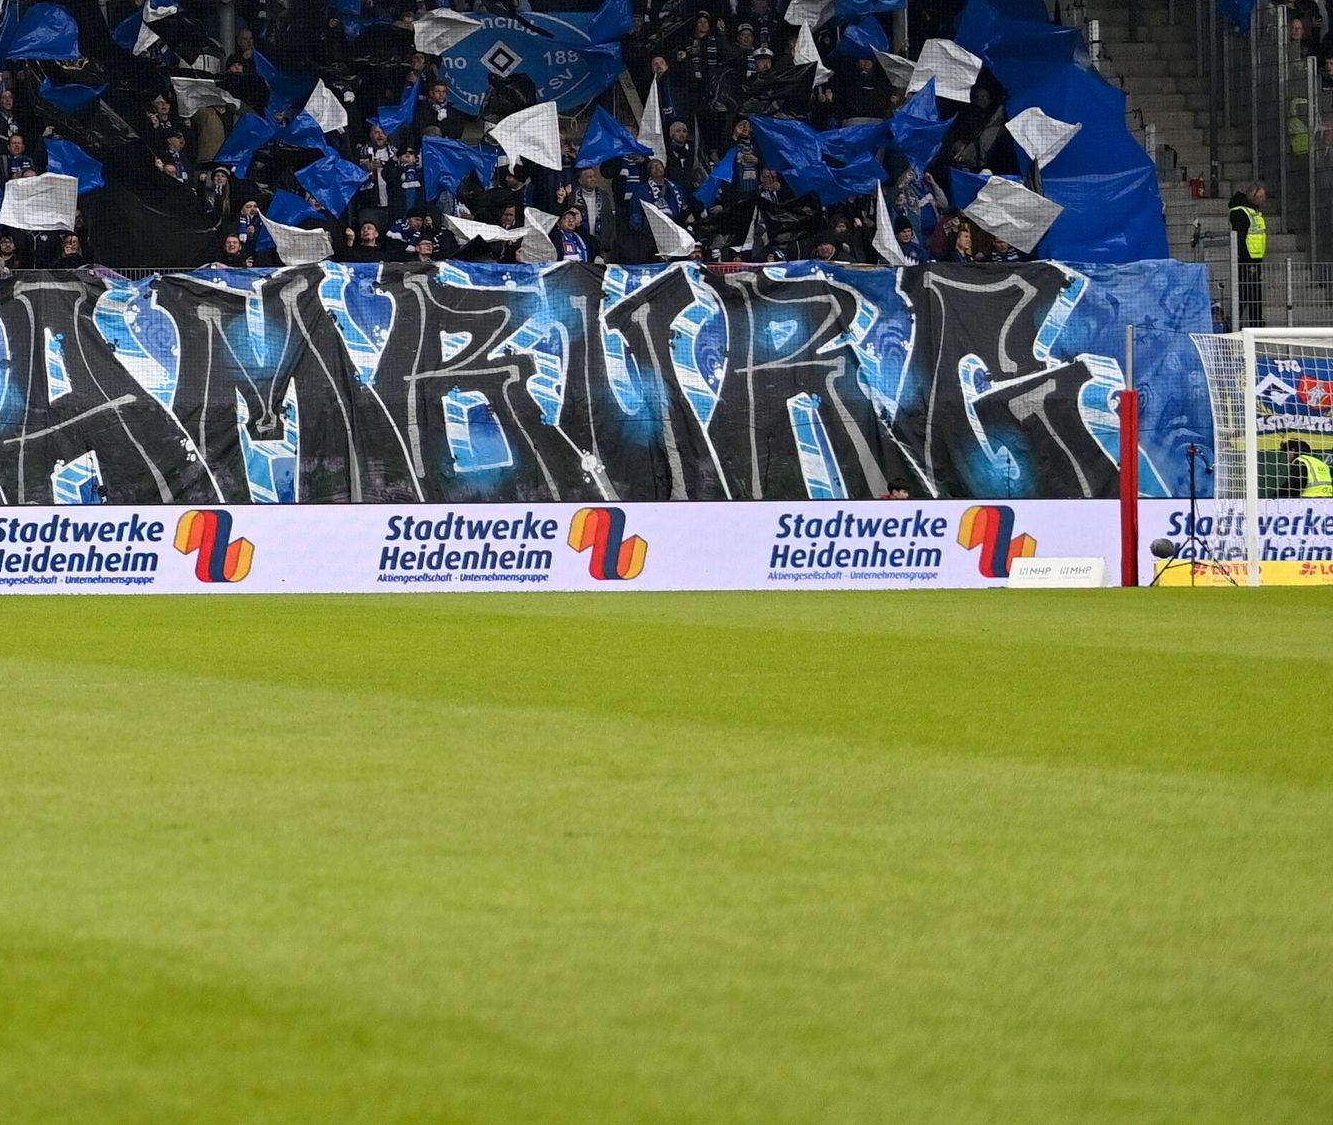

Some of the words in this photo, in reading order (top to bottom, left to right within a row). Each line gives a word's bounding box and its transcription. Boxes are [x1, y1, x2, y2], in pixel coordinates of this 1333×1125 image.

[542, 49, 580, 67] 188
[385, 511, 559, 541] Stadtwerke
[775, 509, 948, 539] Stadtwerke
[379, 543, 552, 571] Heidenheim
[770, 541, 942, 569] Heidenheim
[767, 570, 842, 582] Aktiengesellschaft
[850, 570, 938, 582] Unternehmensgruppe
[1029, 566, 1052, 575] MHP
[1069, 566, 1092, 575] MHP
[1213, 563, 1262, 576] LOTT
[65, 575, 154, 587] Unternehmensgruppe
[376, 573, 452, 584] Aktiengesellschaft
[460, 573, 549, 584] Unternehmensgruppe
